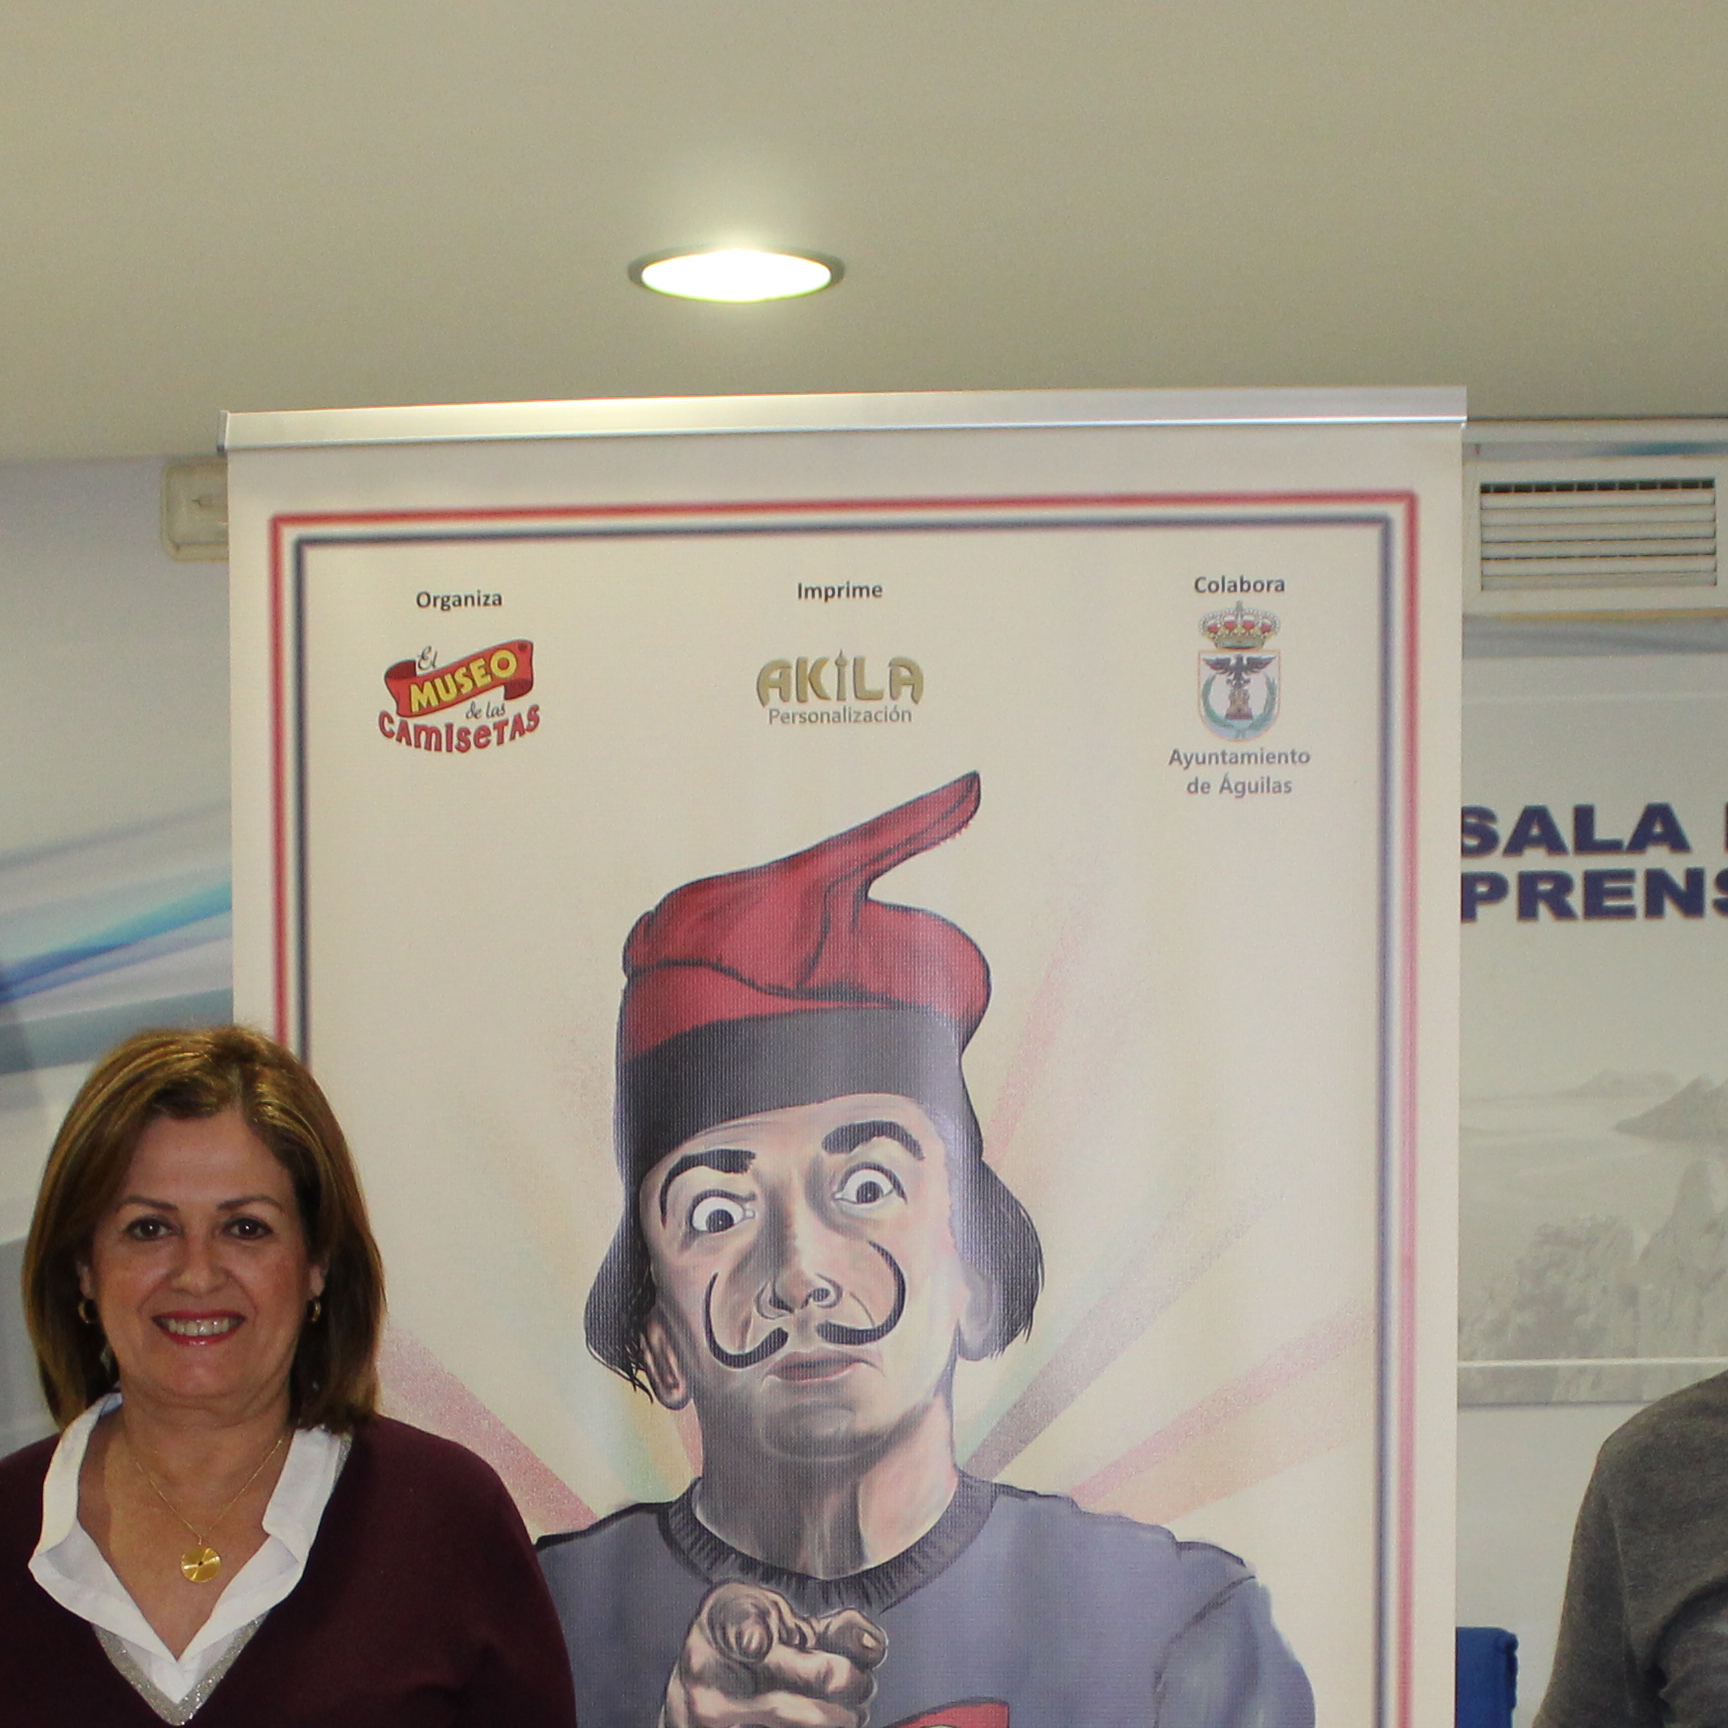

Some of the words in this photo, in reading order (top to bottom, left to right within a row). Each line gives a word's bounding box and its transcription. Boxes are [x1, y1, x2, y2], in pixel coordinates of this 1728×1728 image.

[798, 581, 883, 602] Imprime
[1194, 575, 1286, 593] Colabora
[416, 589, 502, 611] Organiza
[417, 645, 438, 670] El
[410, 649, 518, 713] MUSEO
[756, 649, 924, 708] AKILA
[465, 702, 482, 720] de
[486, 702, 506, 719] las
[769, 705, 913, 724] Personalización
[1168, 748, 1311, 770] Ayuntamiento
[1186, 777, 1211, 794] de
[1218, 772, 1293, 798] Águilas
[1460, 801, 1690, 858] SALA
